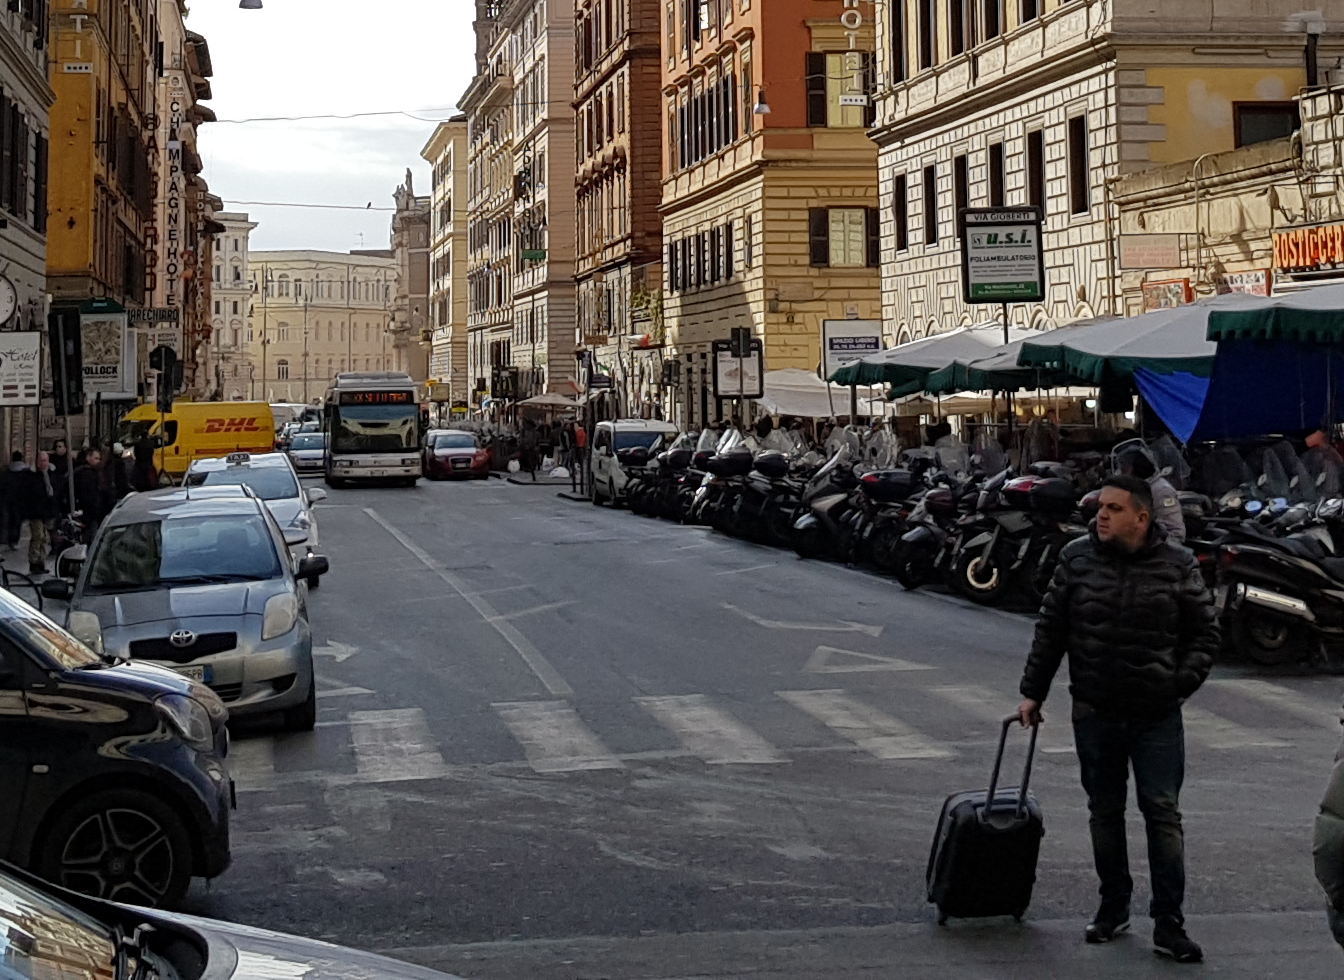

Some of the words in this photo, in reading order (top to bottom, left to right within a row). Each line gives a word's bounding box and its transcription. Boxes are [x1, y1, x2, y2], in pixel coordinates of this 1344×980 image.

[974, 213, 989, 221] VIA
[990, 212, 1030, 220] GIOBERTI
[166, 249, 179, 307] HOTE
[205, 417, 260, 433] DHL
